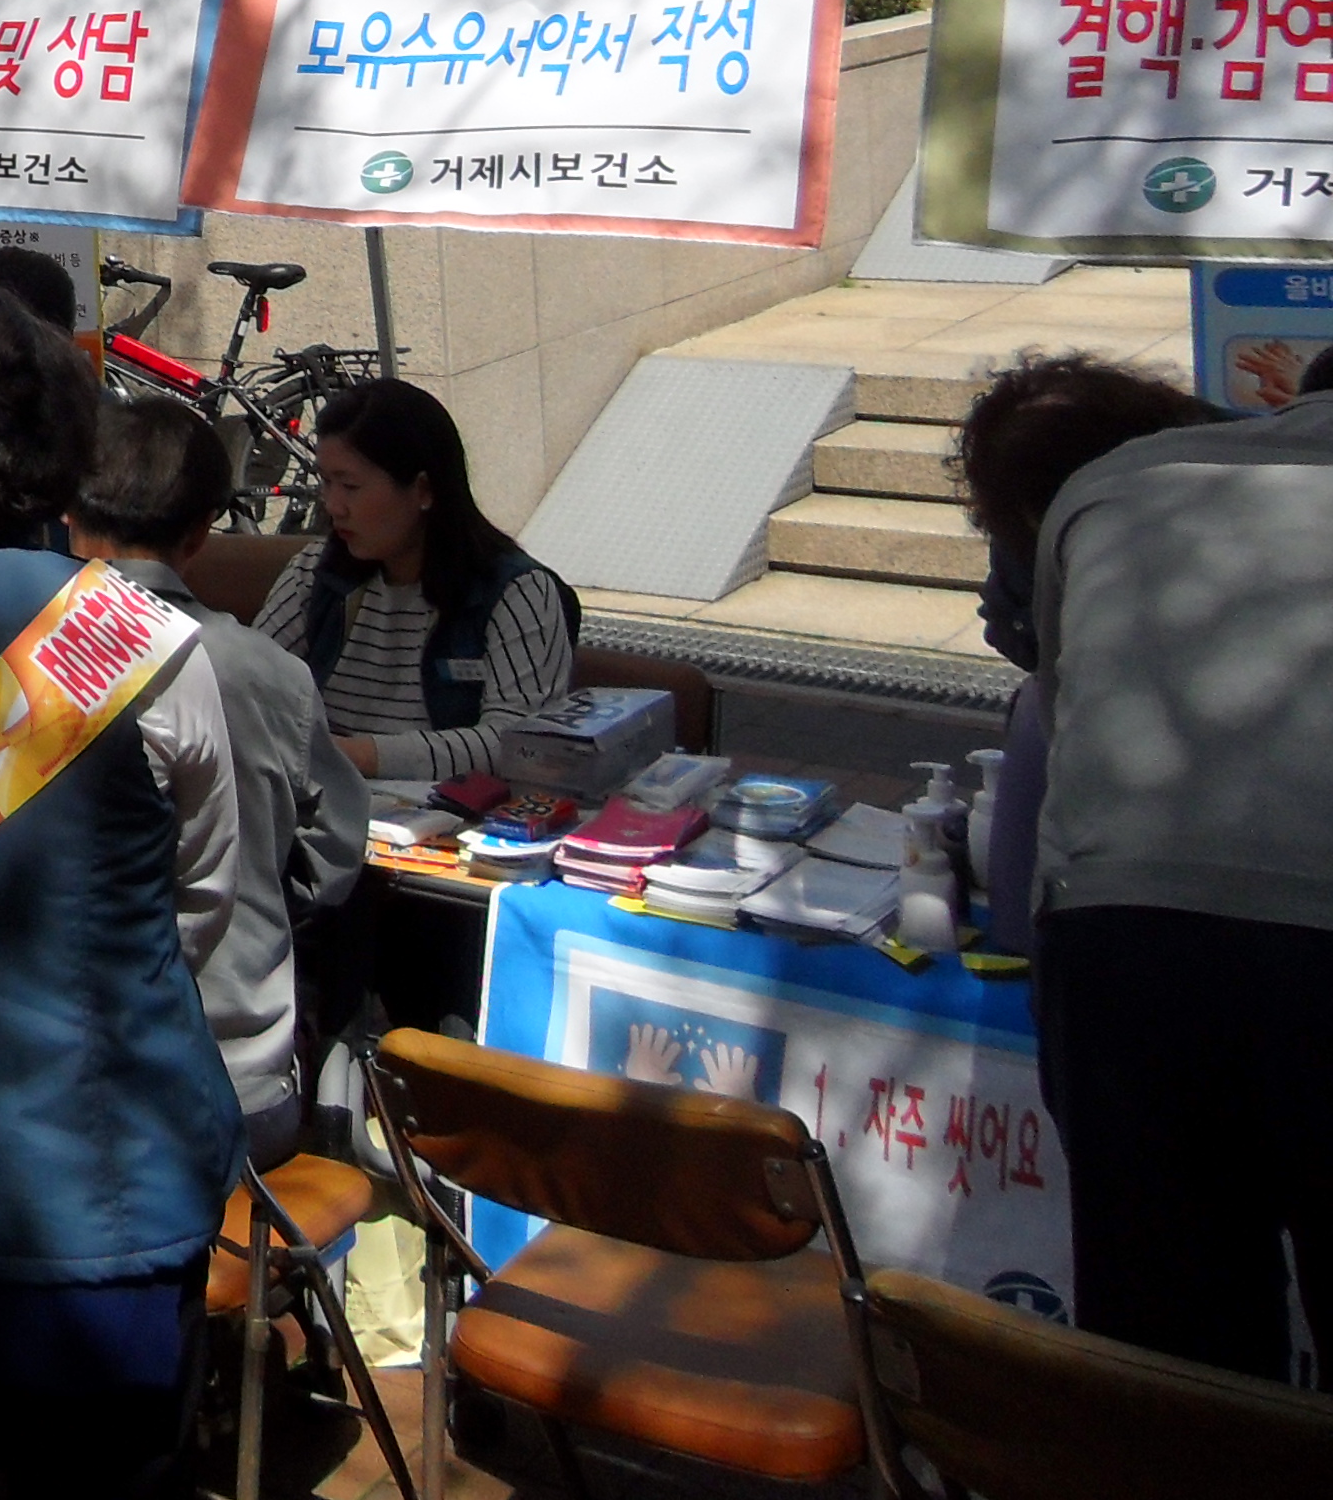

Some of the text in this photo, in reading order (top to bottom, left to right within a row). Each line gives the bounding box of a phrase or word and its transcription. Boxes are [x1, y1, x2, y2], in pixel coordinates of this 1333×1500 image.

[47, 10, 150, 102] 상담
[296, 11, 637, 96] 모유수유서약서
[429, 150, 678, 189] 거제시보건소
[862, 1077, 928, 1171] 자주
[943, 1095, 1045, 1198] 씻어요
